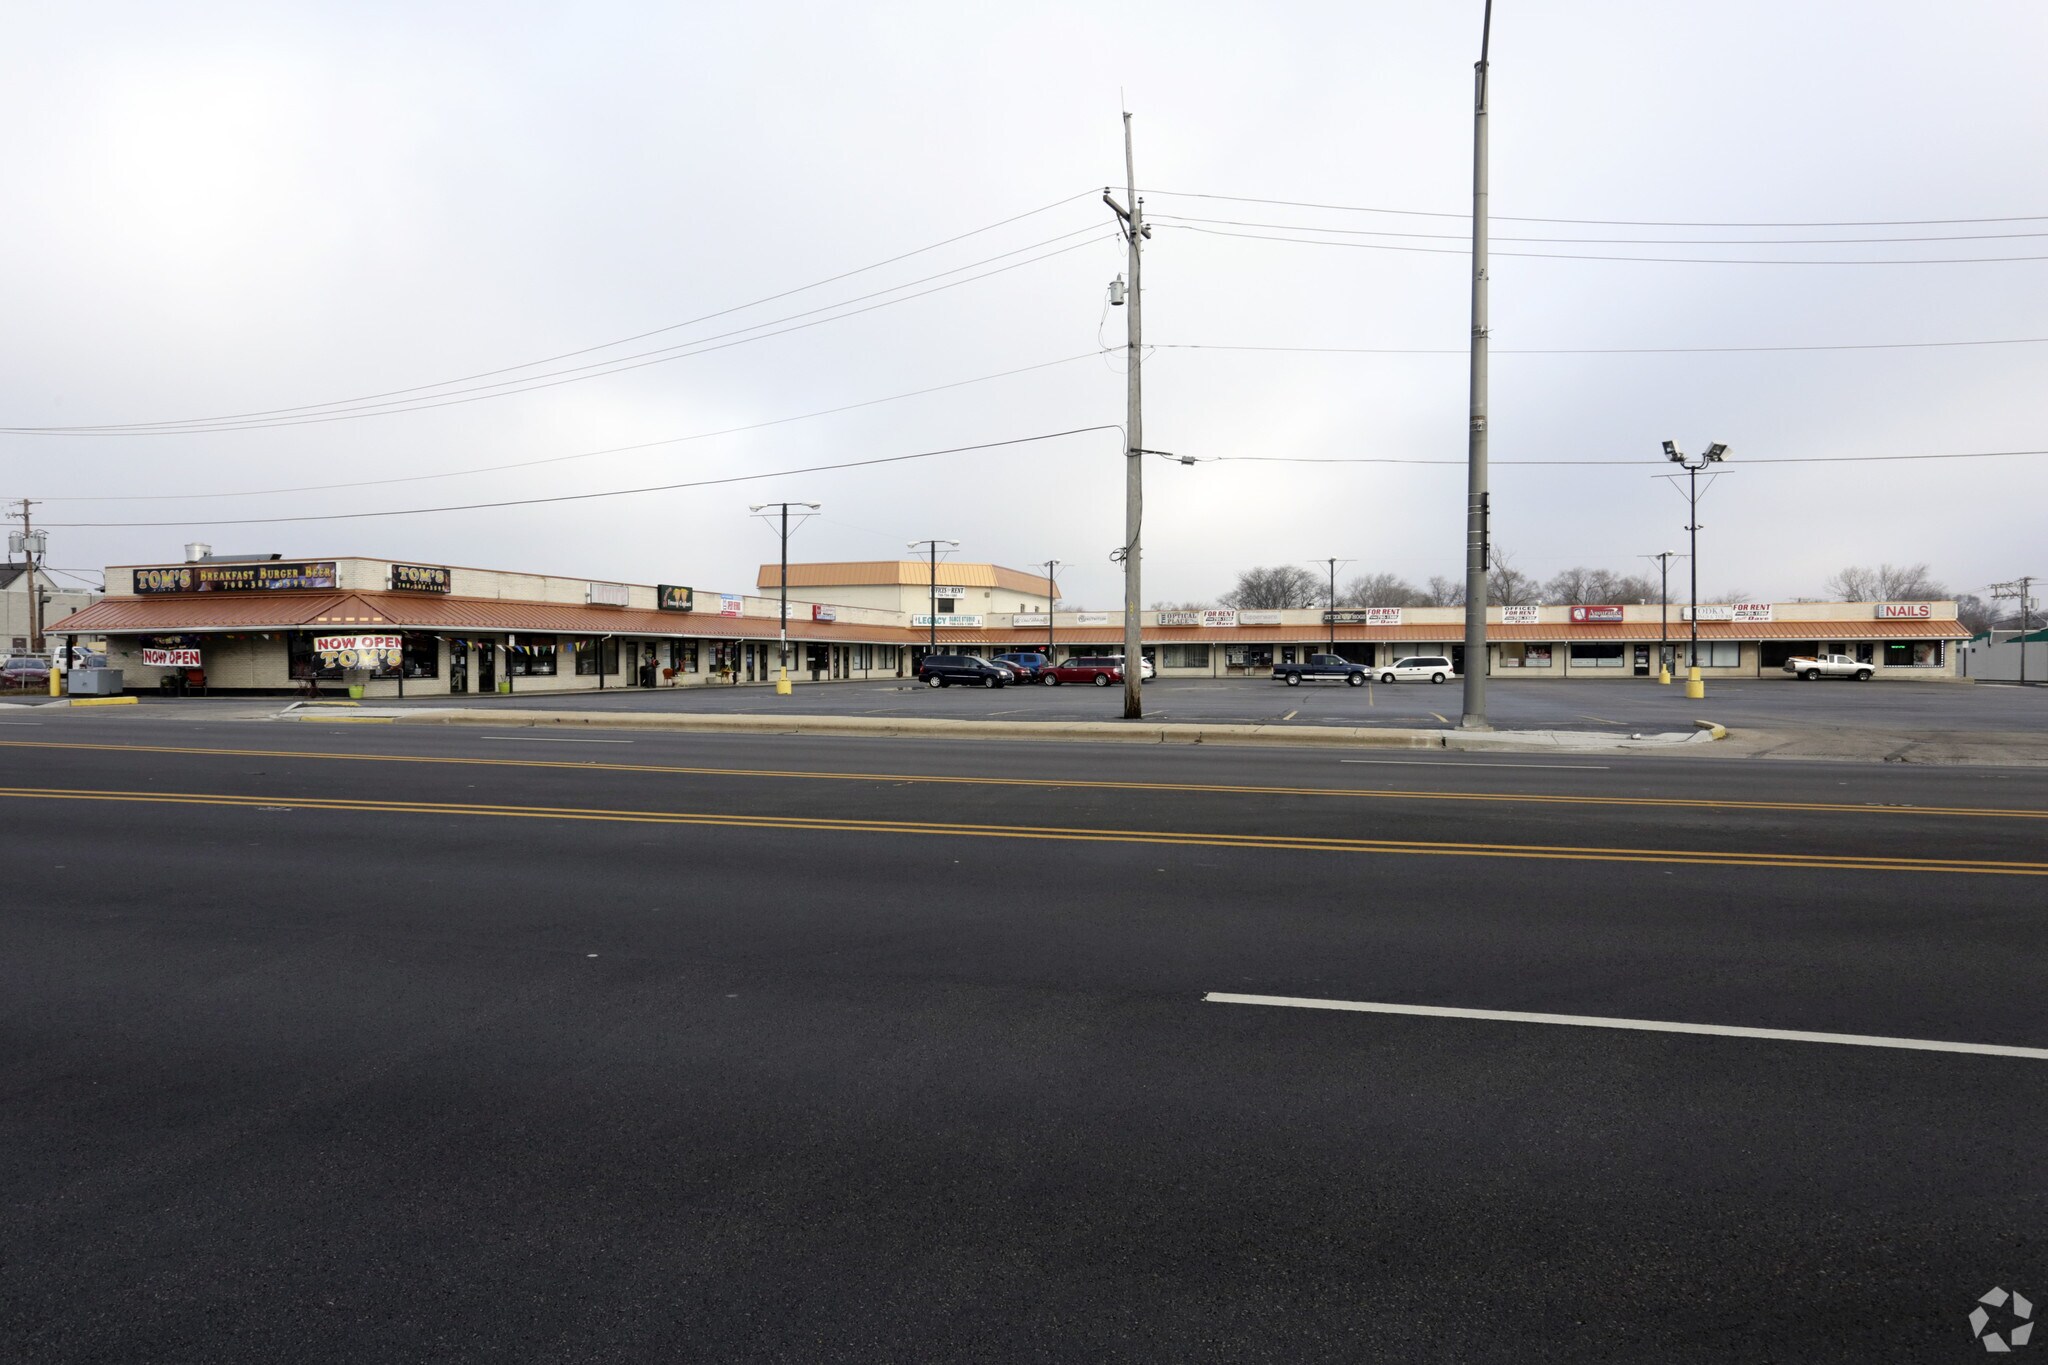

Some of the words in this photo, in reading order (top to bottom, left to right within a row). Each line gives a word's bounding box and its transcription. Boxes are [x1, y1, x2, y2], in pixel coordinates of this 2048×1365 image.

[137, 569, 191, 589] TOM'S
[200, 570, 255, 582] BREAKFAST
[260, 567, 298, 579] BURGER
[305, 566, 331, 578] BEER
[398, 567, 445, 583] TOM'S
[1886, 605, 1929, 617] NAILS
[318, 637, 356, 650] NOW
[361, 636, 402, 648] OPEN
[144, 650, 167, 664] NOW
[170, 650, 200, 665] OPEN
[320, 649, 402, 668] TOM'S
